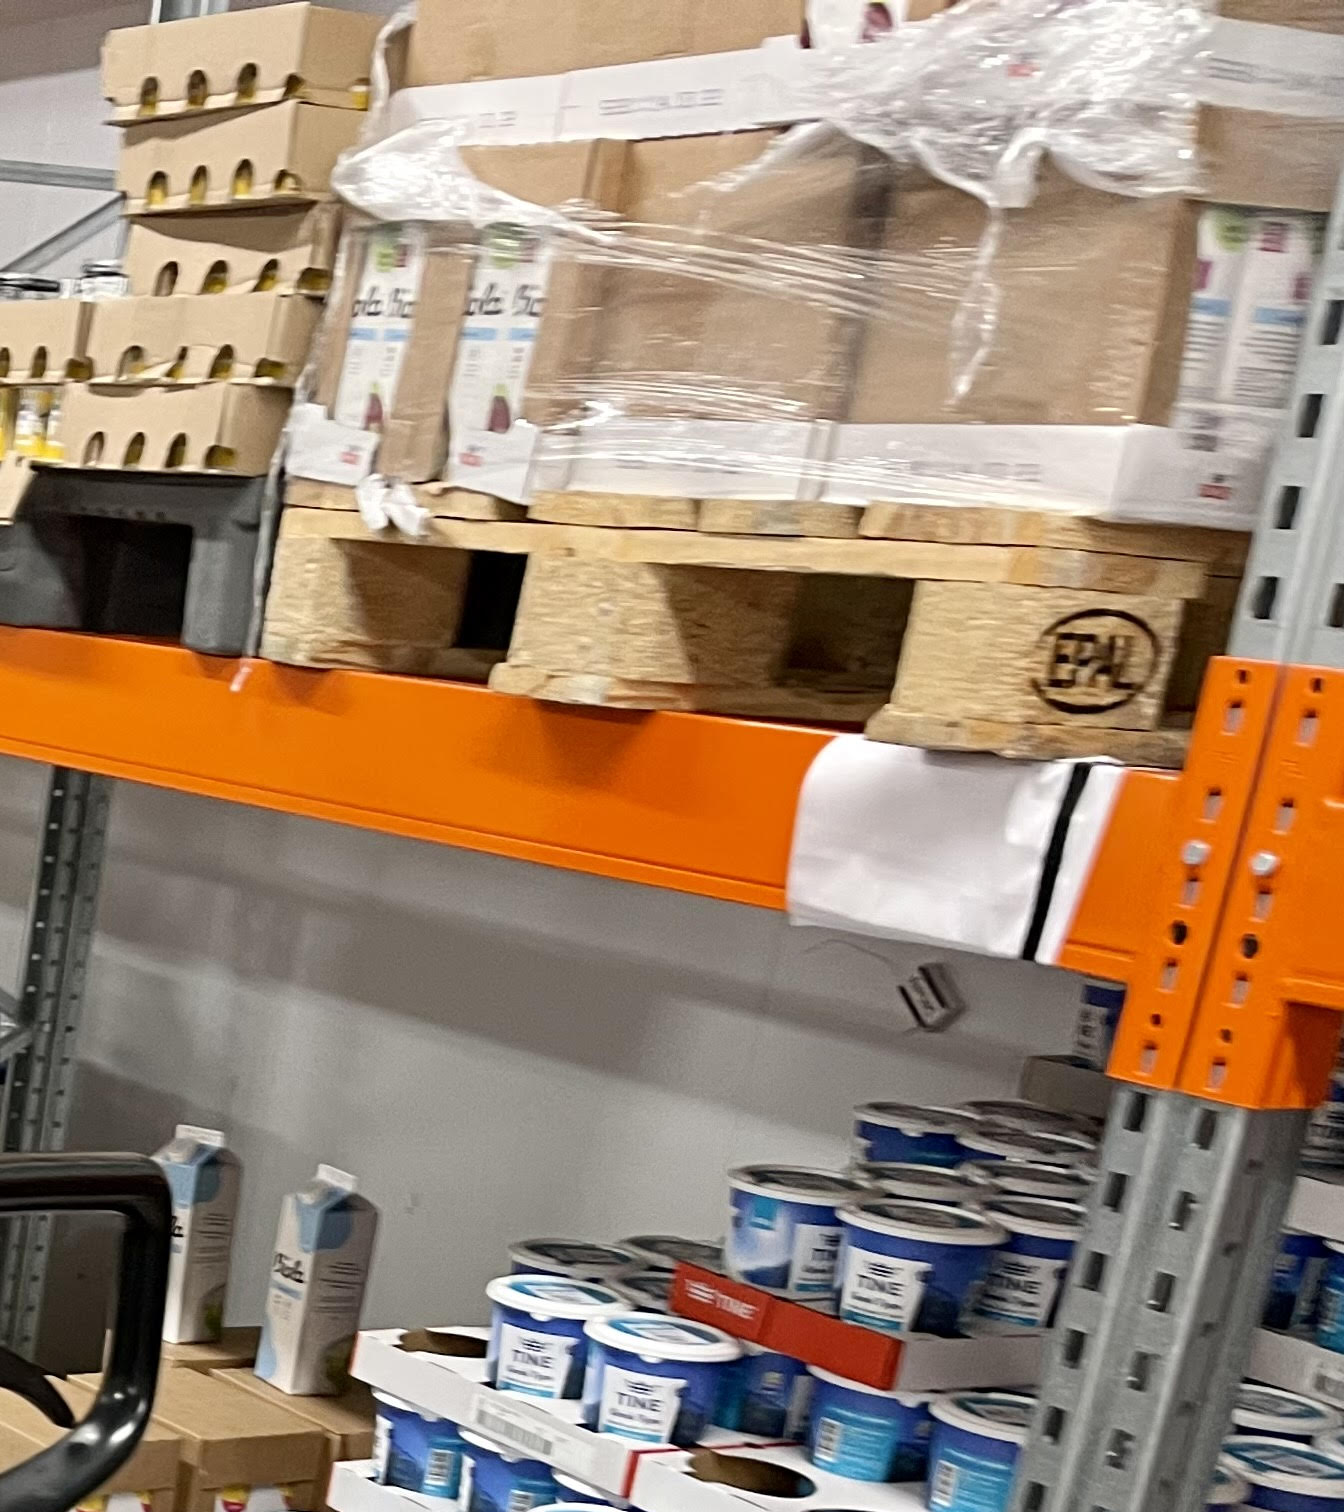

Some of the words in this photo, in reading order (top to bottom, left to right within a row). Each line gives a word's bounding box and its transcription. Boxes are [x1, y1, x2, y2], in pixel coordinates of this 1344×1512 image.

[857, 1273, 906, 1297] TINE
[987, 1271, 1042, 1295] TINE
[713, 1286, 759, 1321] TINE
[513, 1349, 558, 1368] TINE
[617, 1392, 665, 1413] TINE
